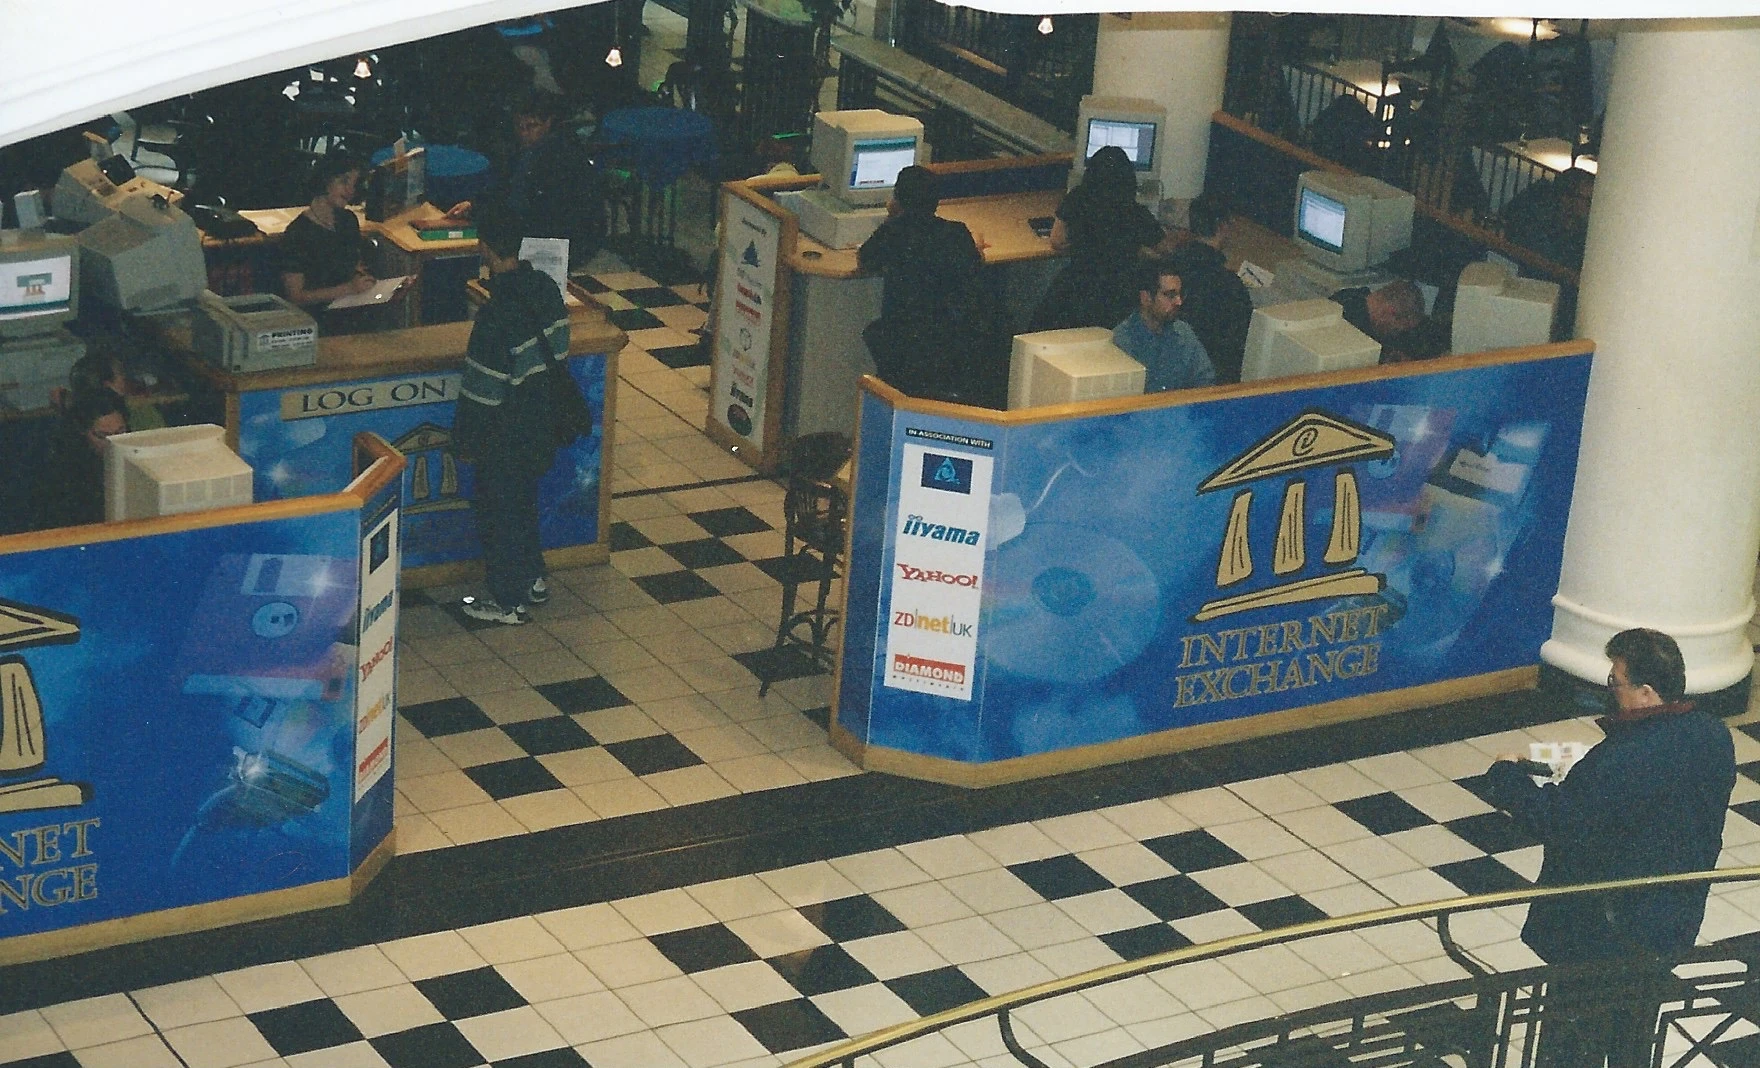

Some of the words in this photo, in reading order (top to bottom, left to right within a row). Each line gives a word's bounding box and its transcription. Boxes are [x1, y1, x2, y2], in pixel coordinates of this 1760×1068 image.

[271, 328, 313, 338] PRINTING
[302, 387, 374, 413] LOG
[390, 379, 447, 402] ON
[918, 431, 969, 444] ASSOCIATION
[970, 438, 991, 448] WITH
[902, 514, 981, 546] iiyama
[1178, 604, 1388, 669] INTERNET
[895, 661, 964, 683] DIAMOND
[1173, 642, 1381, 708] EXCHANGE
[0, 863, 98, 913] NGE
